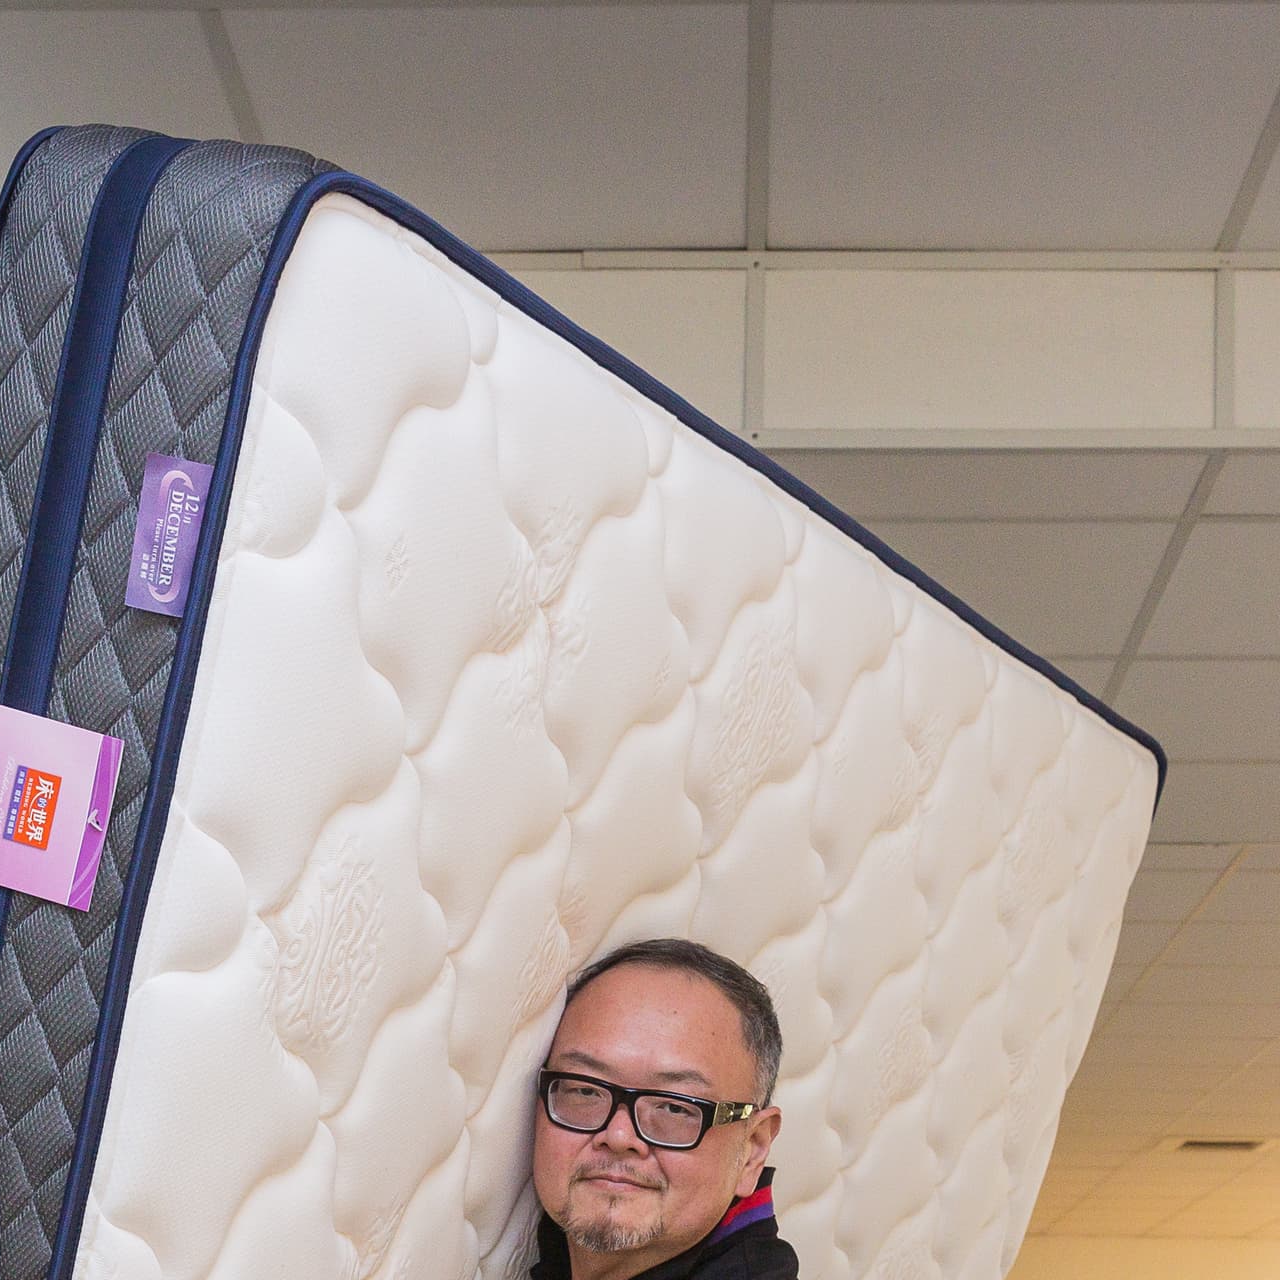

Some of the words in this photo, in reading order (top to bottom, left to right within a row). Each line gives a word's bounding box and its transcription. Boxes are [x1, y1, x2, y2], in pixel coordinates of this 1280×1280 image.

[154, 518, 164, 545] Please
[158, 489, 185, 586] DECEMBER
[151, 545, 159, 565] turn
[148, 565, 156, 582] over
[25, 775, 55, 842] 床的世界
